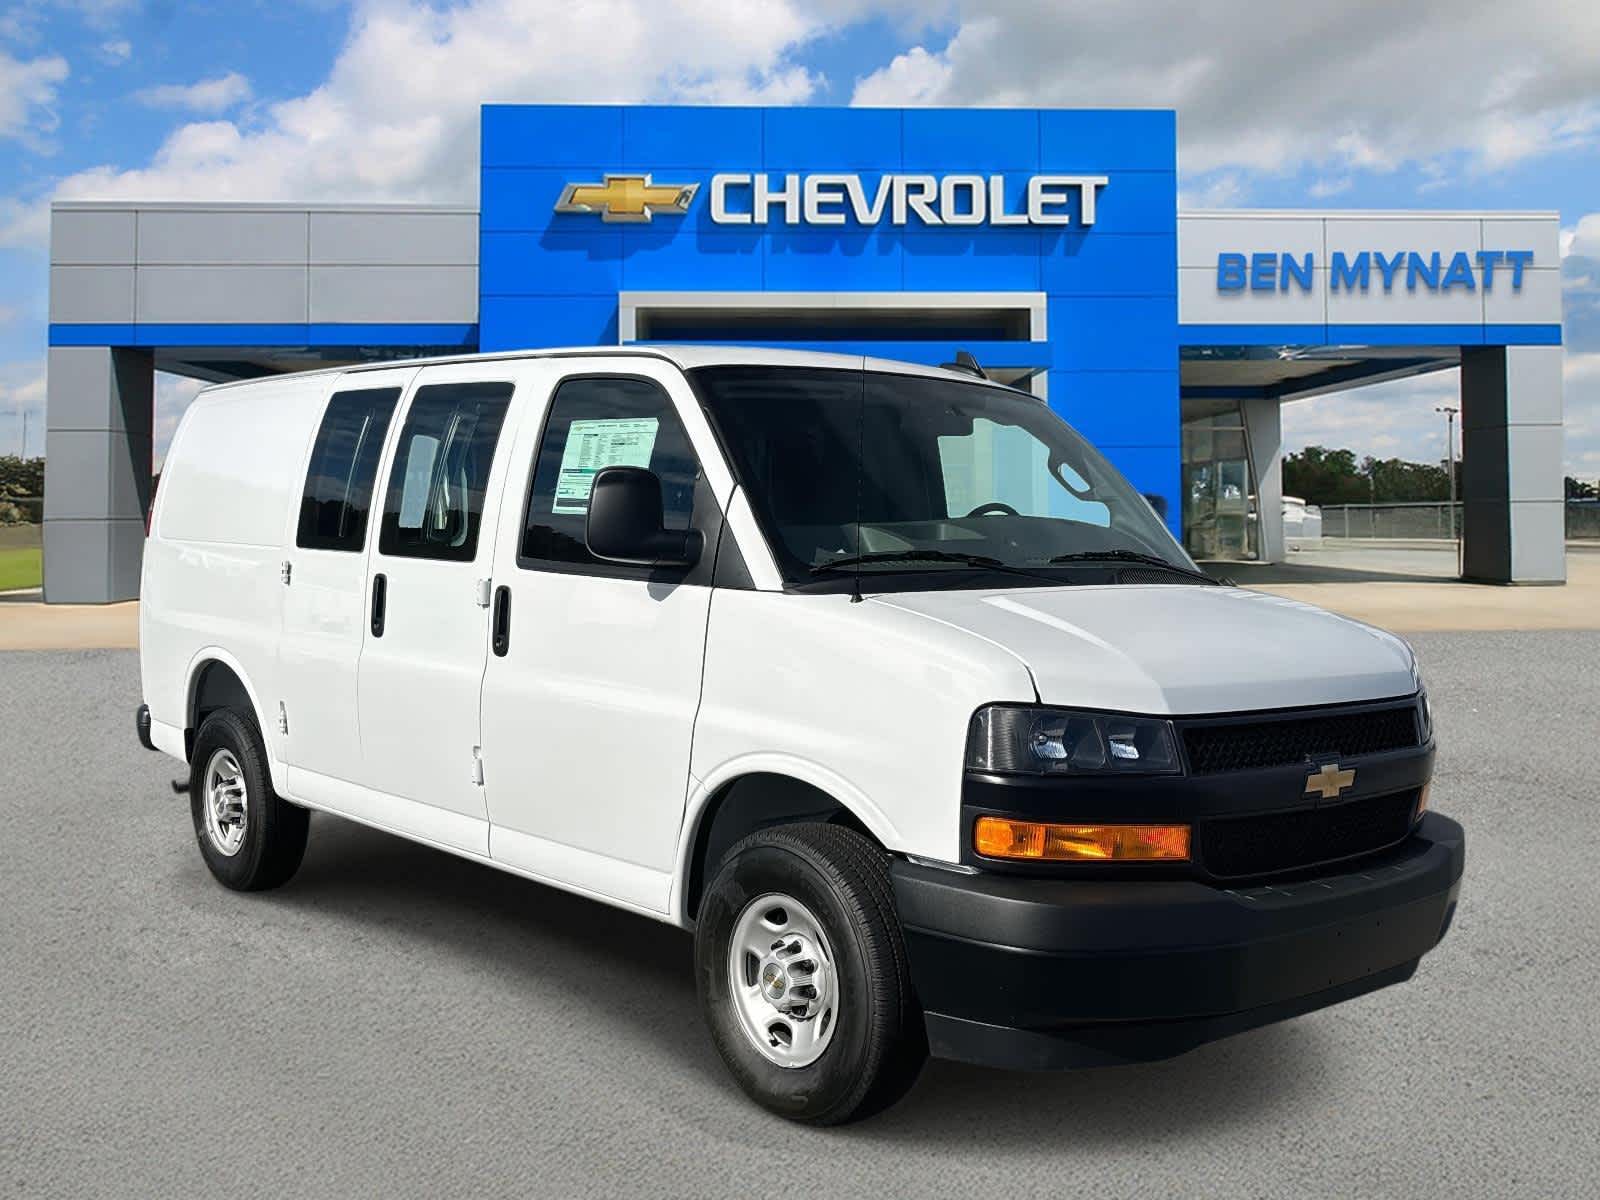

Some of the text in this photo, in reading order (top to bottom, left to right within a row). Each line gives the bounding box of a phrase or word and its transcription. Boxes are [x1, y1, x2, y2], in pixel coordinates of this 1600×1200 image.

[710, 174, 1109, 226] CHEVROLET
[1217, 251, 1534, 291] BEN MYNATT
